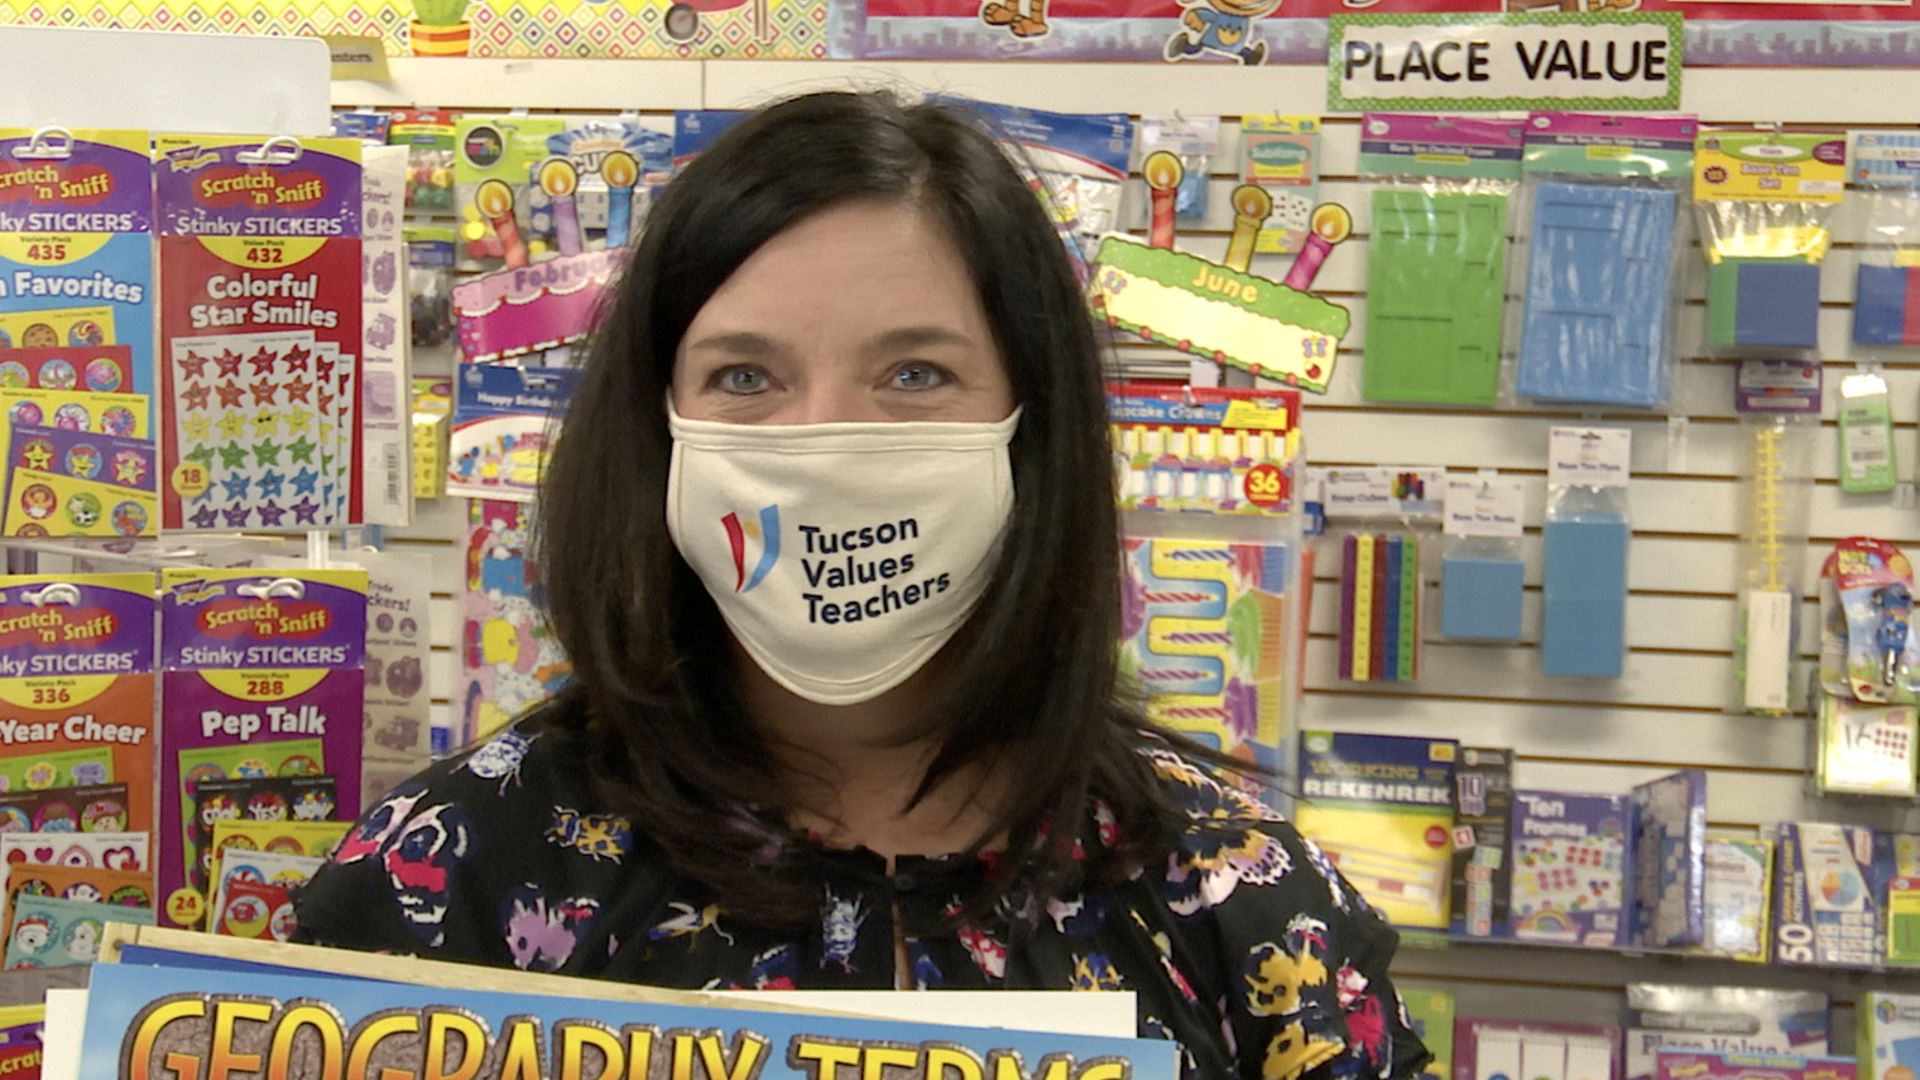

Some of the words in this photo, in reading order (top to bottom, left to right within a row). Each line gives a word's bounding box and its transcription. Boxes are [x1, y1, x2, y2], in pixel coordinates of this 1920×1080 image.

[1344, 40, 1490, 82] PLACE
[1515, 40, 1668, 81] VALUE
[0, 165, 59, 188] cratch
[59, 174, 109, 198] Sniff
[201, 172, 275, 197] Scratch
[274, 180, 322, 203] Sniff
[28, 213, 133, 231] STICKERS
[177, 216, 241, 236] Stinky
[244, 217, 342, 234] STICKERS
[27, 245, 66, 260] 435
[246, 248, 283, 263] 432
[14, 271, 143, 304] Favorites
[206, 272, 318, 299] Colorful
[1191, 265, 1258, 303] June
[190, 304, 248, 328] Star
[251, 300, 338, 328] Smiles
[477, 392, 514, 407] Happy
[180, 469, 201, 483] 18
[1250, 470, 1281, 494] 36
[798, 517, 918, 554] Tucson
[801, 553, 914, 588] Values
[367, 593, 412, 613] ckers!
[802, 572, 950, 624] Teachers
[0, 609, 63, 633] cratch
[63, 616, 112, 640] Sniff
[205, 603, 279, 629] Scratch
[279, 610, 326, 633] Sniff
[30, 653, 134, 672] STICKERS
[181, 646, 243, 667] Stinky
[247, 646, 346, 664] STICKERS
[33, 688, 70, 704] 336
[247, 681, 284, 695] 288
[63, 714, 147, 744] Cheer
[201, 711, 261, 741] Pep
[266, 706, 327, 735] Talk
[1303, 778, 1450, 803] REKENREK
[1518, 795, 1565, 818] Ten
[1523, 818, 1586, 838] Frames
[175, 896, 198, 911] 24
[1779, 923, 1814, 963] 50
[0, 1049, 42, 1074] crat
